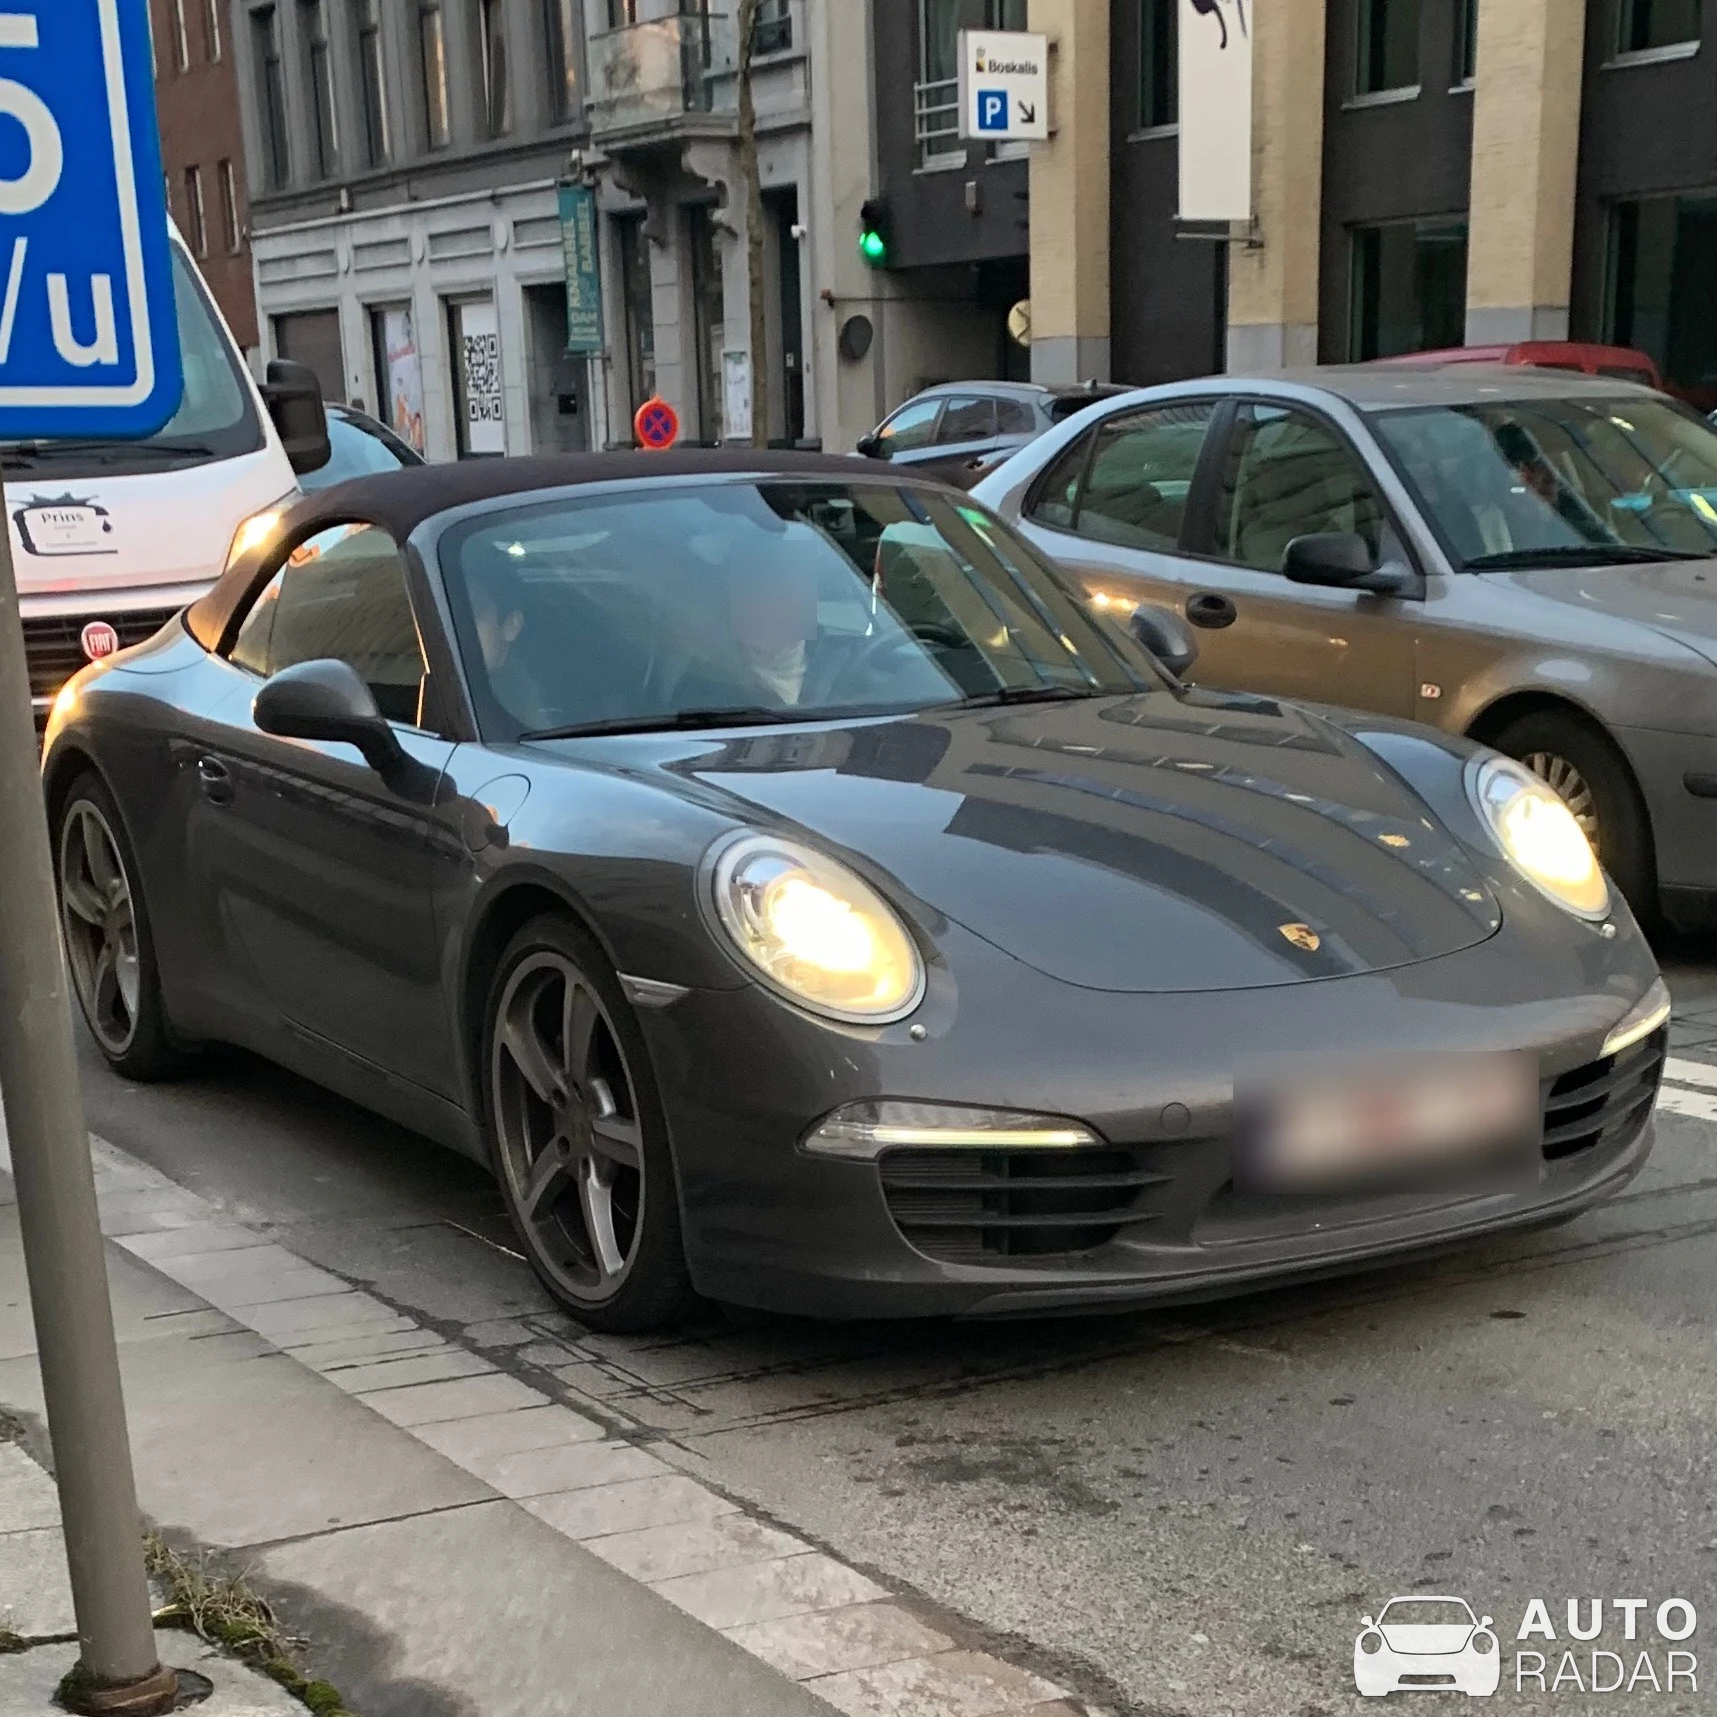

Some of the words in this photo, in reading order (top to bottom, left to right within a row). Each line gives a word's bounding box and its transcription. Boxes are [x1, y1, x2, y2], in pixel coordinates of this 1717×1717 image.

[988, 59, 1038, 75] Boskalis
[985, 96, 1002, 127] P
[41, 510, 84, 524] Prins
[88, 632, 111, 653] FIAT
